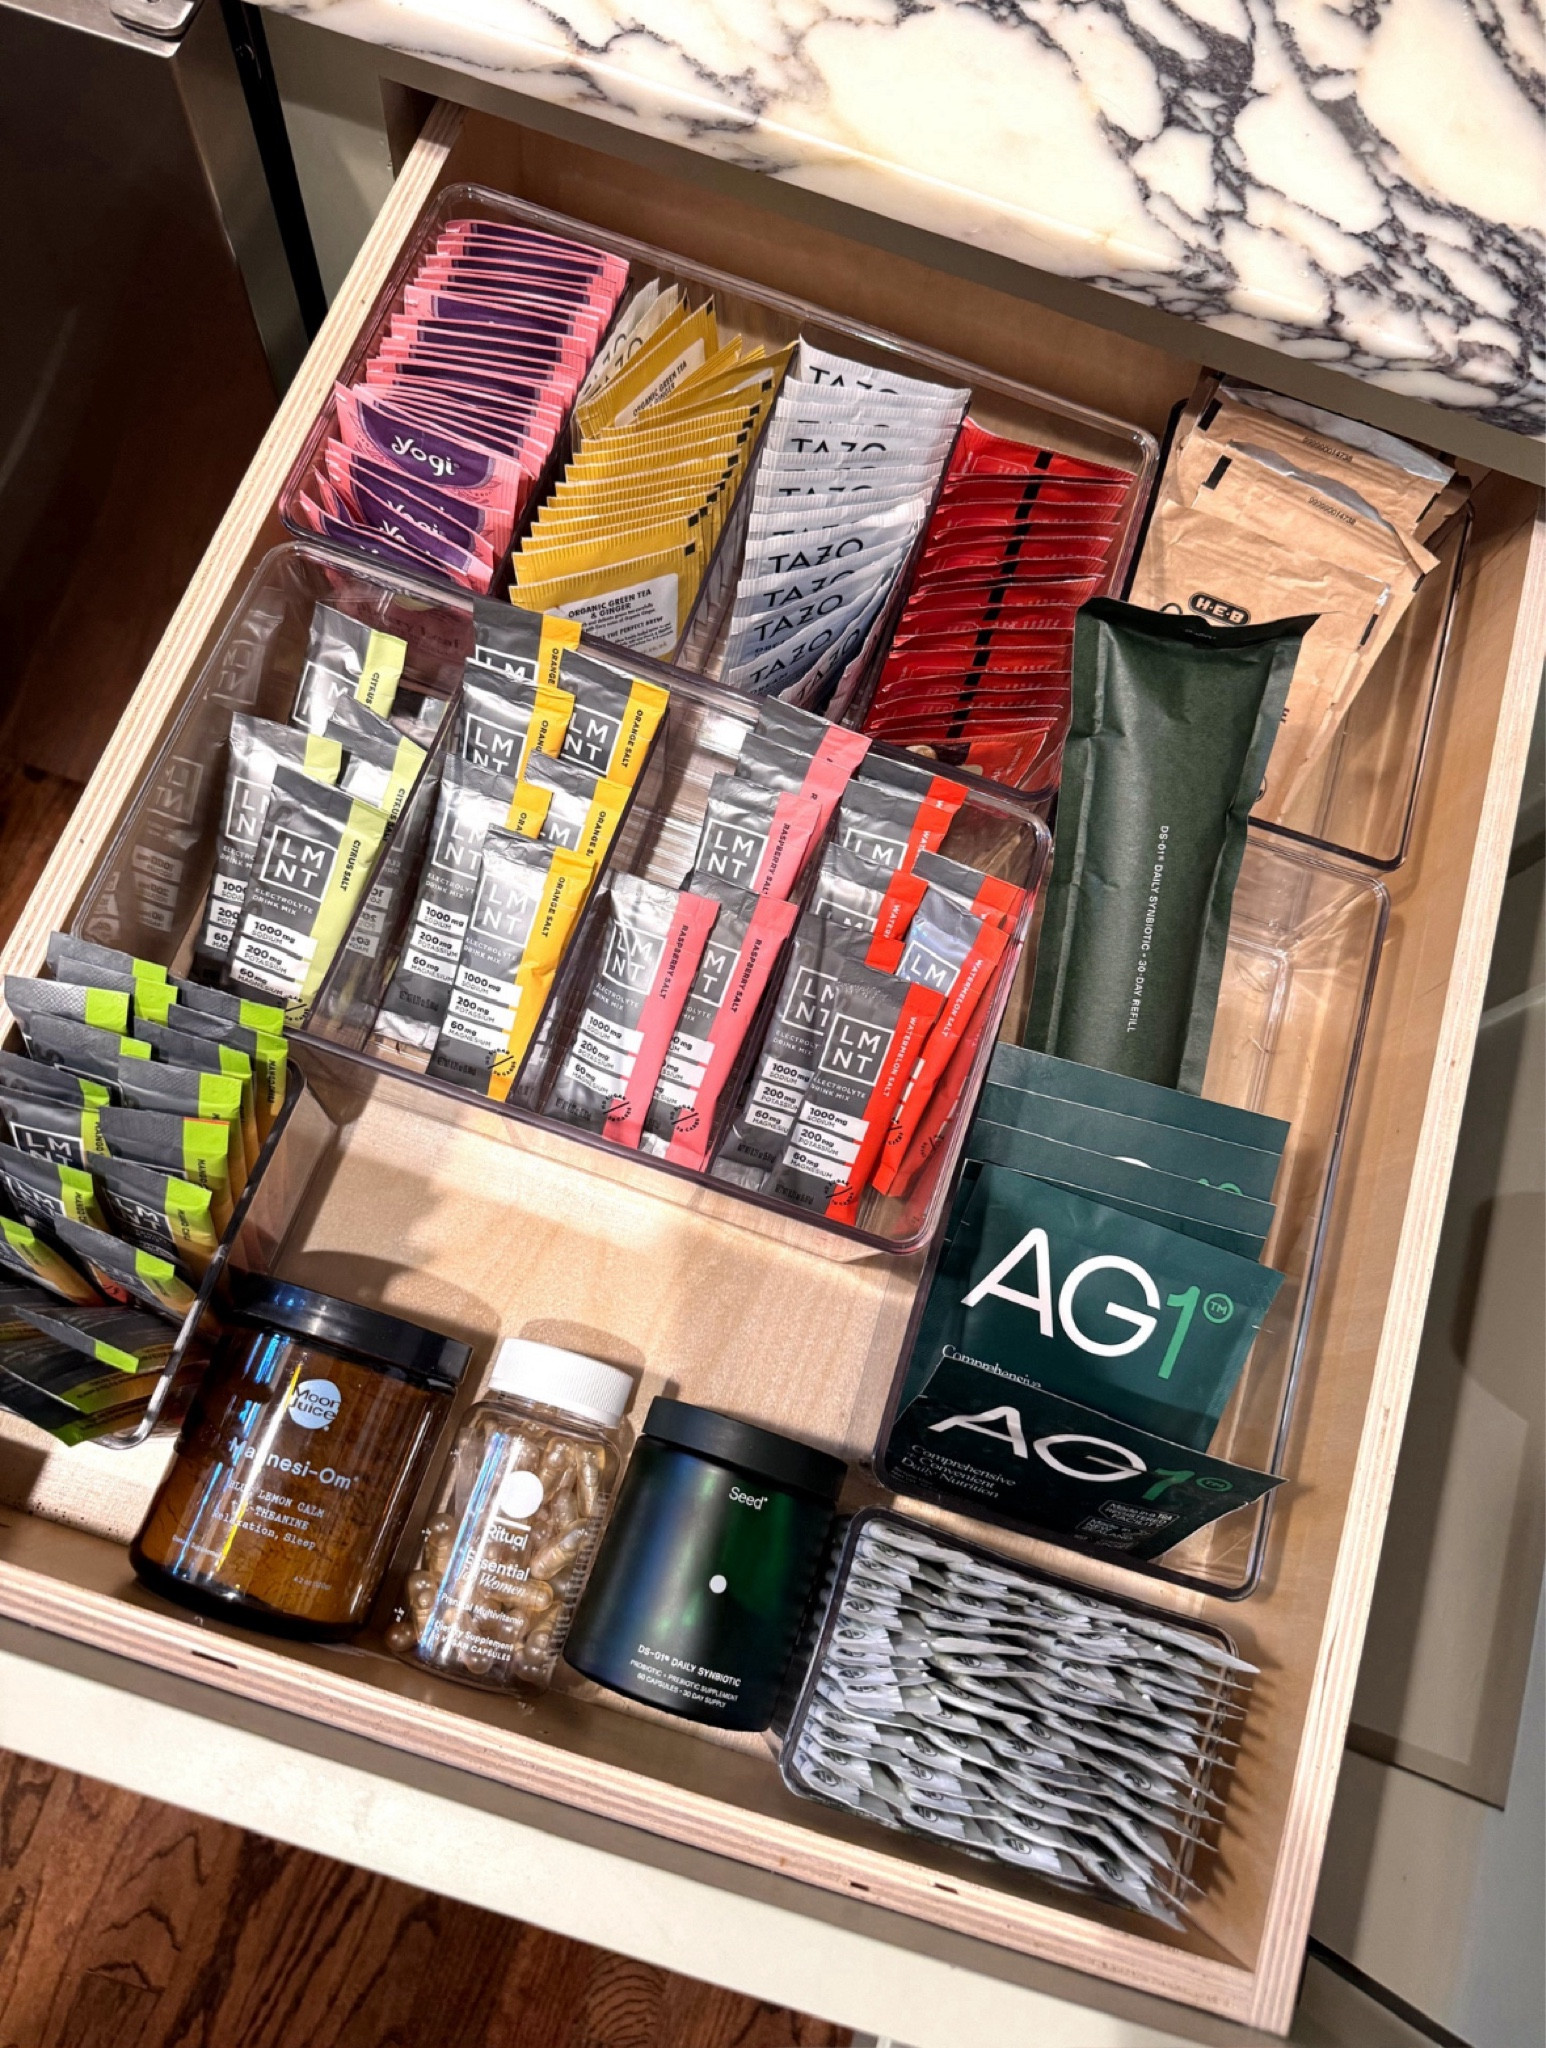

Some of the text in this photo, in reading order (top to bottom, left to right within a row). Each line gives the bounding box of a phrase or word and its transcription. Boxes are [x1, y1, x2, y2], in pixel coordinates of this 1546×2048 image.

[391, 435, 455, 476] Yogi
[768, 538, 863, 573] TAZO
[569, 602, 606, 618] ORGANIC
[608, 594, 635, 607] GREEN
[637, 589, 651, 599] TEA
[600, 603, 631, 617] GINGER
[620, 622, 644, 635] PERFECT
[645, 616, 662, 626] BREW
[754, 595, 843, 640] TAZO
[548, 648, 559, 684] ORANGE
[750, 629, 832, 683] TAZO
[569, 712, 608, 743] LM
[622, 709, 643, 768] ORANGE SALT
[475, 728, 514, 757] LM
[564, 734, 602, 761] NT
[473, 750, 508, 772] NT
[390, 788, 405, 820] CITRUS
[590, 811, 606, 848] ORANGE
[282, 838, 325, 868] LM
[444, 842, 482, 869] NT
[714, 831, 754, 857] LM
[771, 823, 790, 875] RASPBERRY
[274, 860, 319, 888] NT
[341, 840, 361, 891] CITRUS SALT
[707, 852, 747, 878] NT
[1150, 864, 1163, 894] DAILY
[255, 888, 313, 914] ELECTROLYTE
[450, 890, 464, 898] MIX
[489, 884, 528, 913] LM
[542, 877, 565, 937] ORANGE SALT
[219, 907, 239, 919] 200
[282, 905, 296, 915] MIX
[426, 906, 464, 927] 1000 mg
[482, 906, 522, 934] NT
[1141, 896, 1158, 950] SYNBIOTIC
[214, 933, 228, 941] 60
[254, 922, 282, 936] 1000
[419, 932, 452, 950] 200 mg
[246, 945, 269, 958] 200
[413, 957, 439, 972] 60 mg
[660, 925, 689, 999] RASPBERRY SALT
[240, 968, 254, 978] 60
[464, 972, 501, 992] 1000 mg
[612, 955, 645, 982] NT
[730, 939, 762, 1013] RASPBERRY SALT
[910, 953, 947, 987] LM
[457, 996, 489, 1015] 200 mg
[942, 960, 983, 1037] WATERMELON SALT
[455, 1006, 494, 1022] POTASSIUM
[589, 1016, 610, 1032] 1000
[1127, 998, 1141, 1033] REFILL
[451, 1021, 476, 1036] 60 mg
[840, 1025, 881, 1053] LM
[581, 1041, 598, 1054] 200
[832, 1048, 873, 1073] NT
[883, 1017, 917, 1097] WATERMELON SALT
[575, 1064, 586, 1074] 60
[773, 1063, 810, 1082] 1000 mg
[763, 1087, 796, 1103] 200 mg
[813, 1077, 866, 1098] ELECTROLYTE
[755, 1110, 780, 1124] 60 mg
[810, 1108, 848, 1126] 1000 mg
[26, 1132, 72, 1156] LM
[801, 1129, 834, 1147] 200 mg
[793, 1152, 806, 1162] 60
[961, 1228, 1200, 1379] AG1
[290, 1398, 336, 1420] Juice
[229, 1437, 351, 1489] Manesi-Om
[912, 1445, 1015, 1486] Comprehensive
[919, 1457, 994, 1488] Convenient
[902, 1457, 933, 1476] Daily
[940, 1473, 998, 1498] Nutrition
[258, 1490, 325, 1518] LEMON CALM
[729, 1486, 763, 1510] Seed
[212, 1511, 316, 1550] Relxation, Sleep
[244, 1504, 310, 1530] -THEANINE
[487, 1524, 528, 1551] Ritual
[466, 1546, 530, 1581] Esential
[480, 1572, 526, 1597] Women
[474, 1604, 524, 1625] Multivitamin
[466, 1630, 514, 1651] Supplement
[471, 1645, 511, 1661] CAPSULES
[631, 1659, 738, 1701] PROBIOTIC PREBIOTIC SUPPLEMENT
[671, 1657, 696, 1672] DAILY
[697, 1667, 741, 1687] SYNBIOTIC
[646, 1676, 678, 1693] CAPSULES
[692, 1693, 704, 1701] DAY
[704, 1697, 726, 1708] SUPPLY
